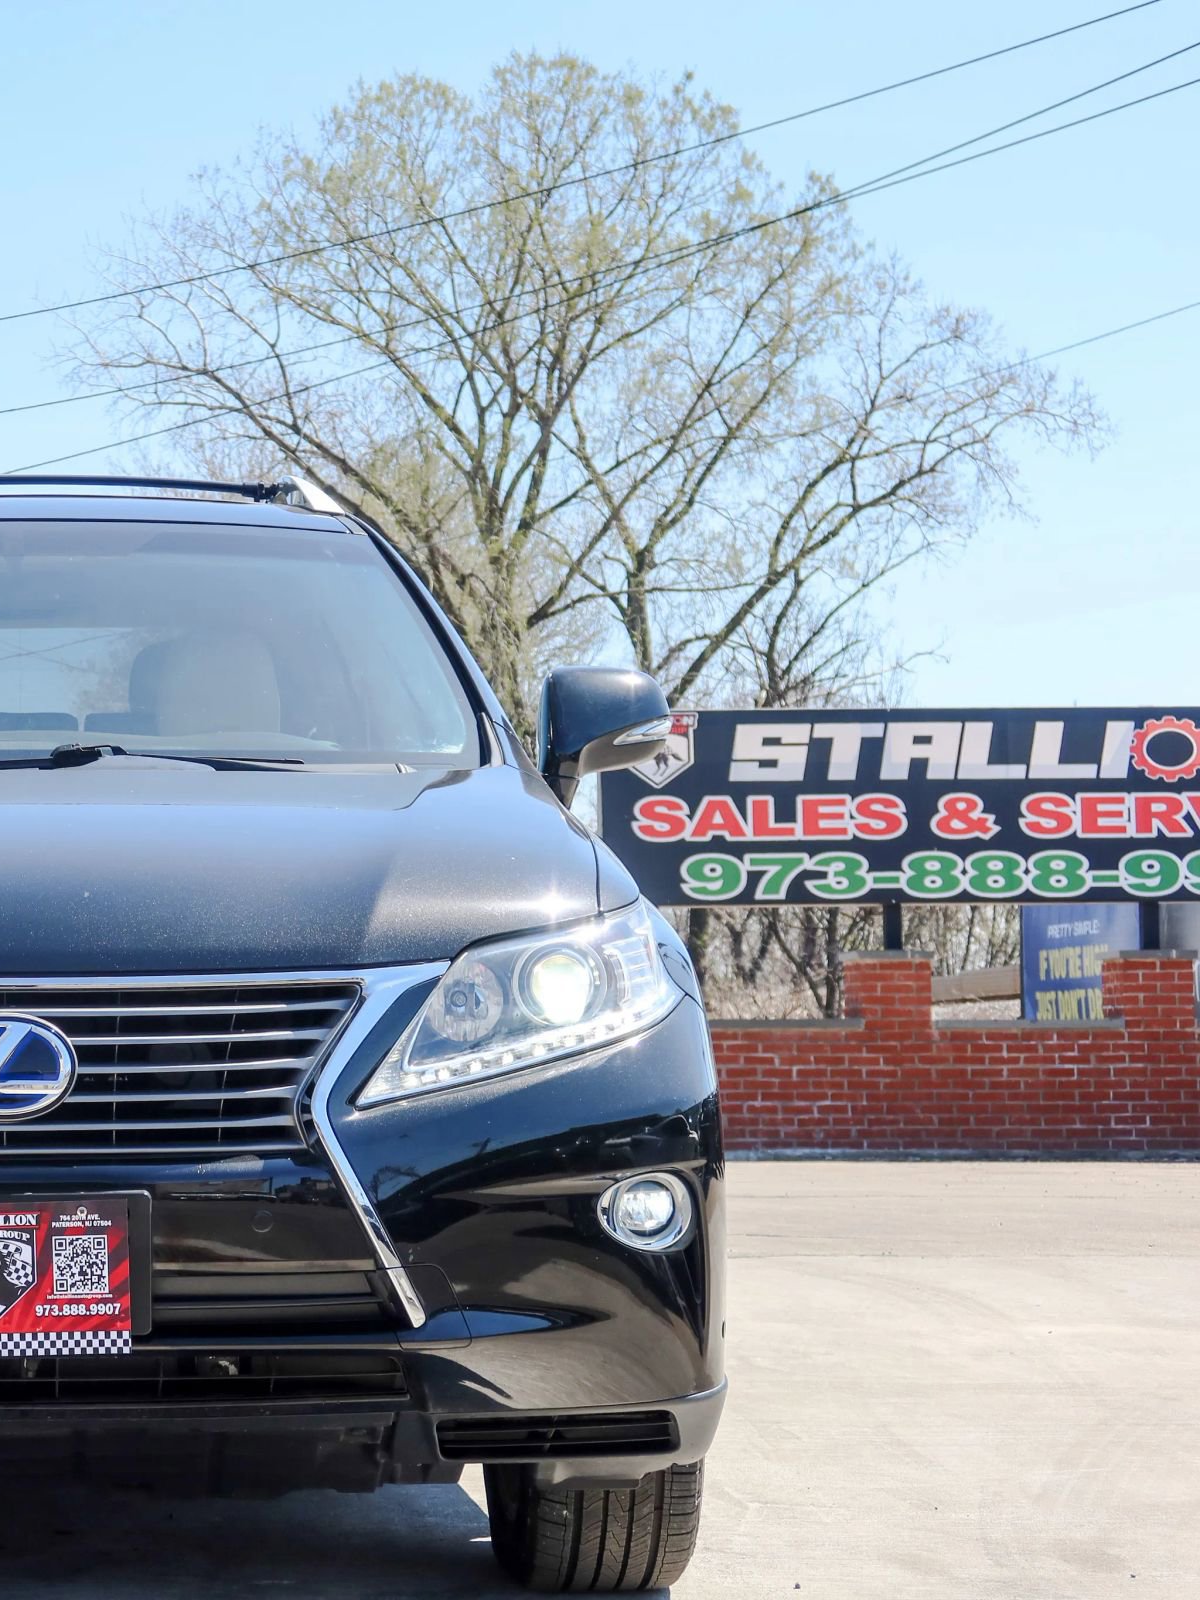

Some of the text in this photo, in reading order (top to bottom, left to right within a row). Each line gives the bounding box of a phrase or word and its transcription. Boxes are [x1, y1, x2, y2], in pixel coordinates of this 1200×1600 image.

[631, 794, 908, 842] SALES
[930, 792, 1002, 840] &
[35, 1302, 121, 1317] 973.888.9907
